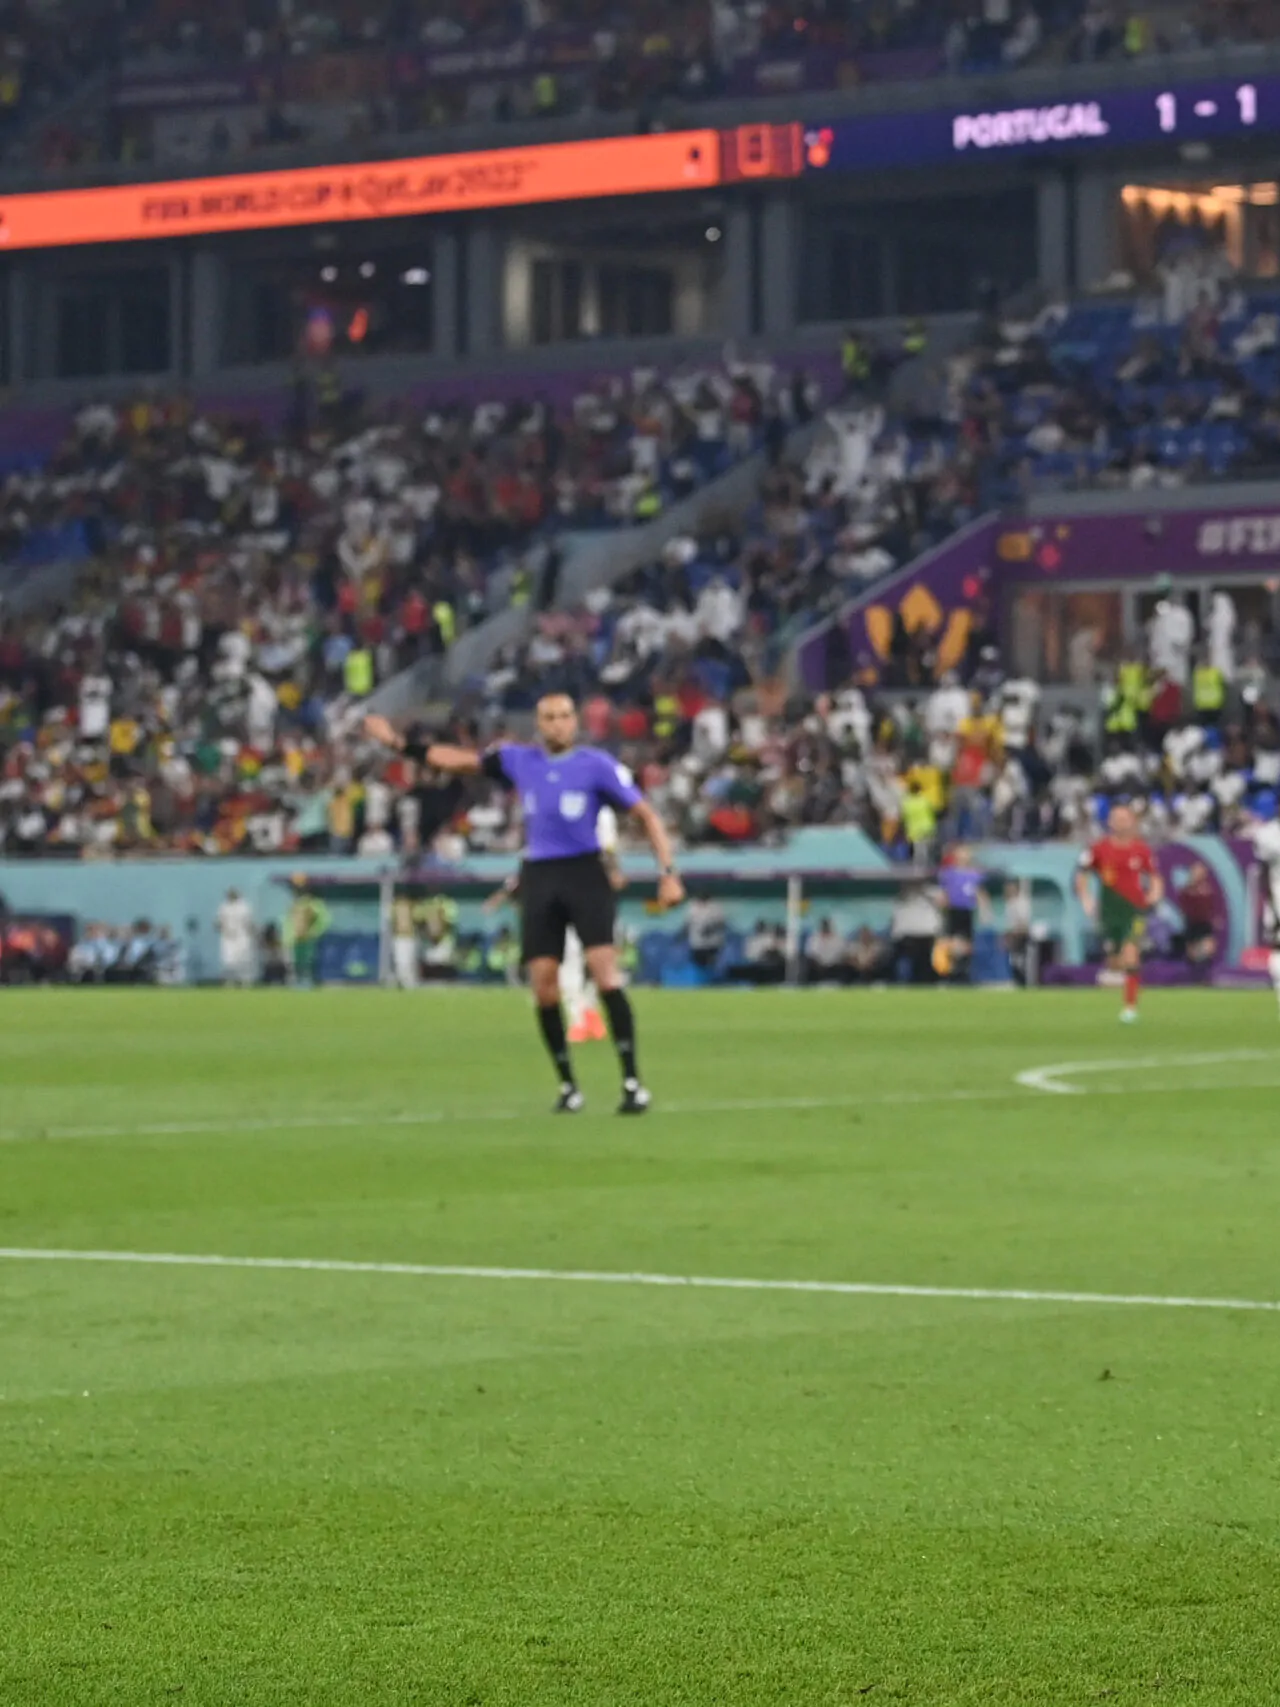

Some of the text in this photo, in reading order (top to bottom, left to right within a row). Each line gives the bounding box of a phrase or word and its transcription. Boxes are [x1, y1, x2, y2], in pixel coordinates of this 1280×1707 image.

[953, 101, 1109, 150] PORTUGAL
[1156, 92, 1175, 132] 1
[1236, 84, 1256, 124] 1
